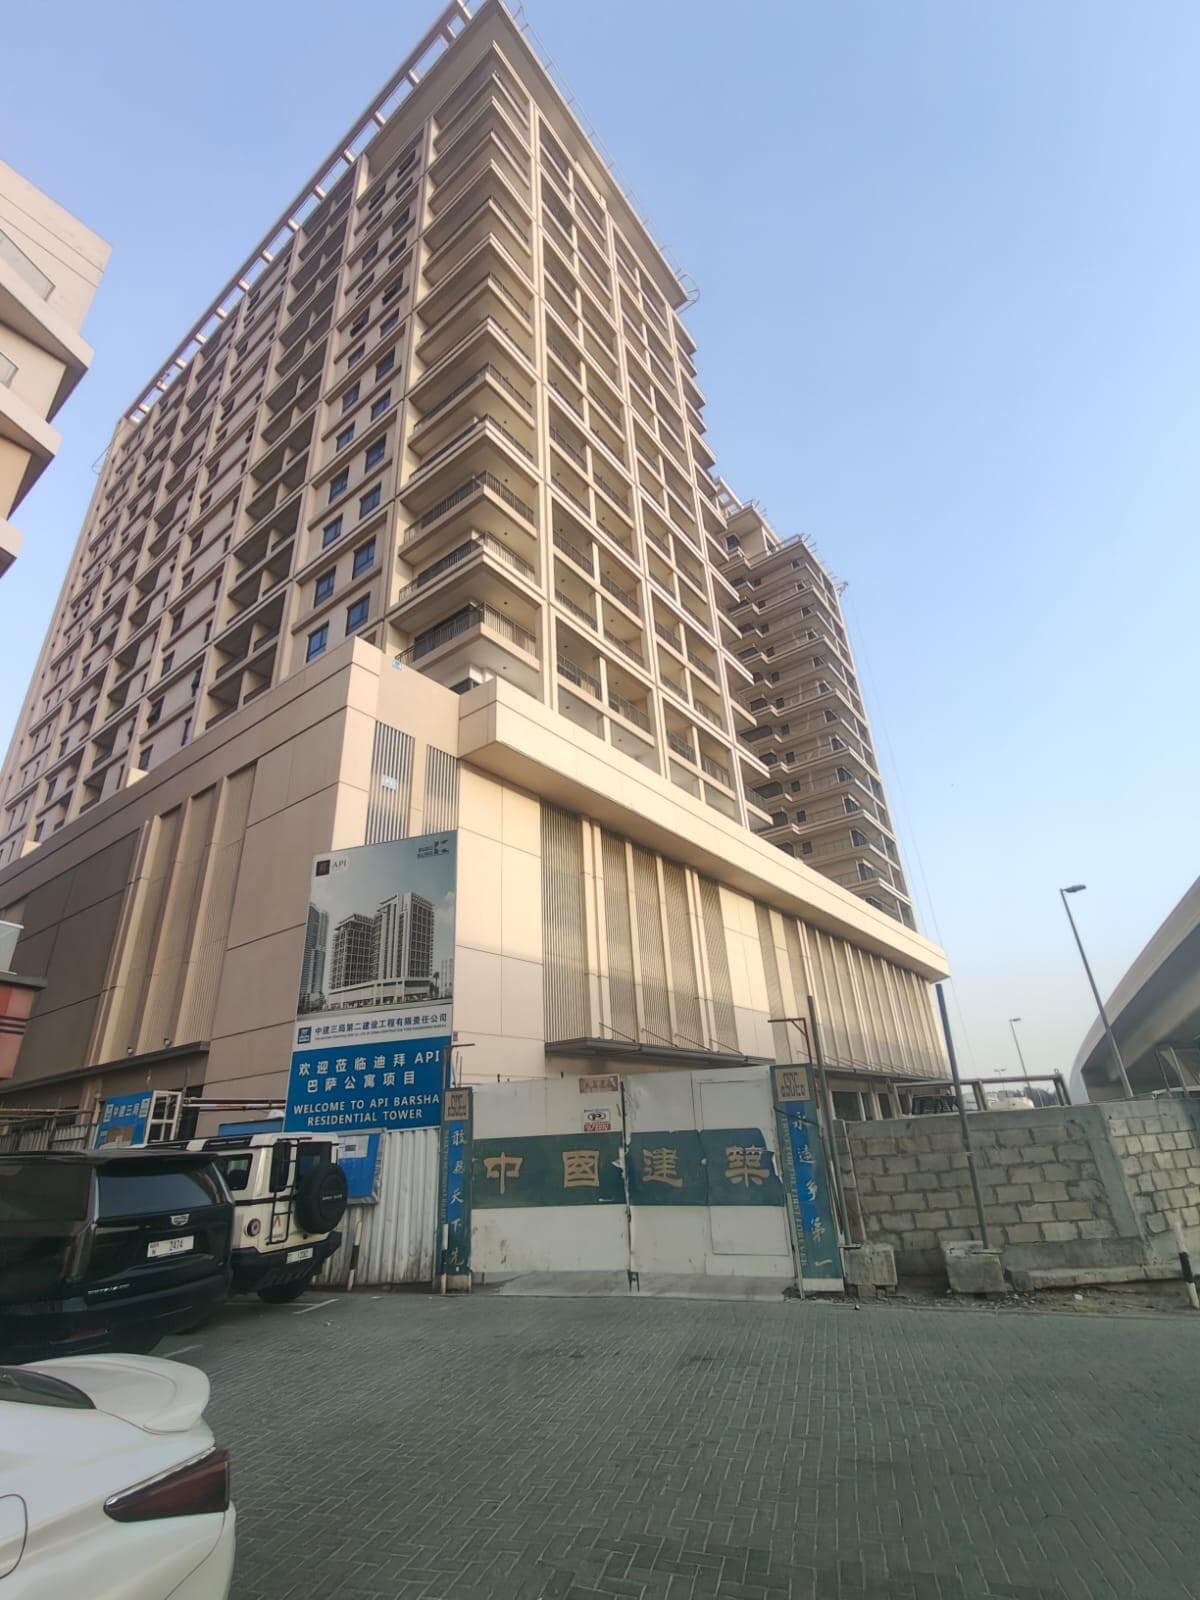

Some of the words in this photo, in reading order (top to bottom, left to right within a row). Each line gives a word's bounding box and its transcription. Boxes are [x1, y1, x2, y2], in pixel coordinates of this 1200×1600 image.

[299, 1053, 406, 1077] 欢迎莅临迪拜
[414, 1050, 440, 1064] API
[307, 1071, 415, 1093] 巴萨公寓项目
[293, 1101, 345, 1115] WELCOME
[350, 1099, 365, 1110] TO
[369, 1097, 389, 1109] API
[394, 1094, 440, 1107] BARSHA
[307, 1111, 377, 1127] RESIDENTIAL
[383, 1108, 423, 1121] TOWER
[483, 1145, 770, 1195] 中國建築
